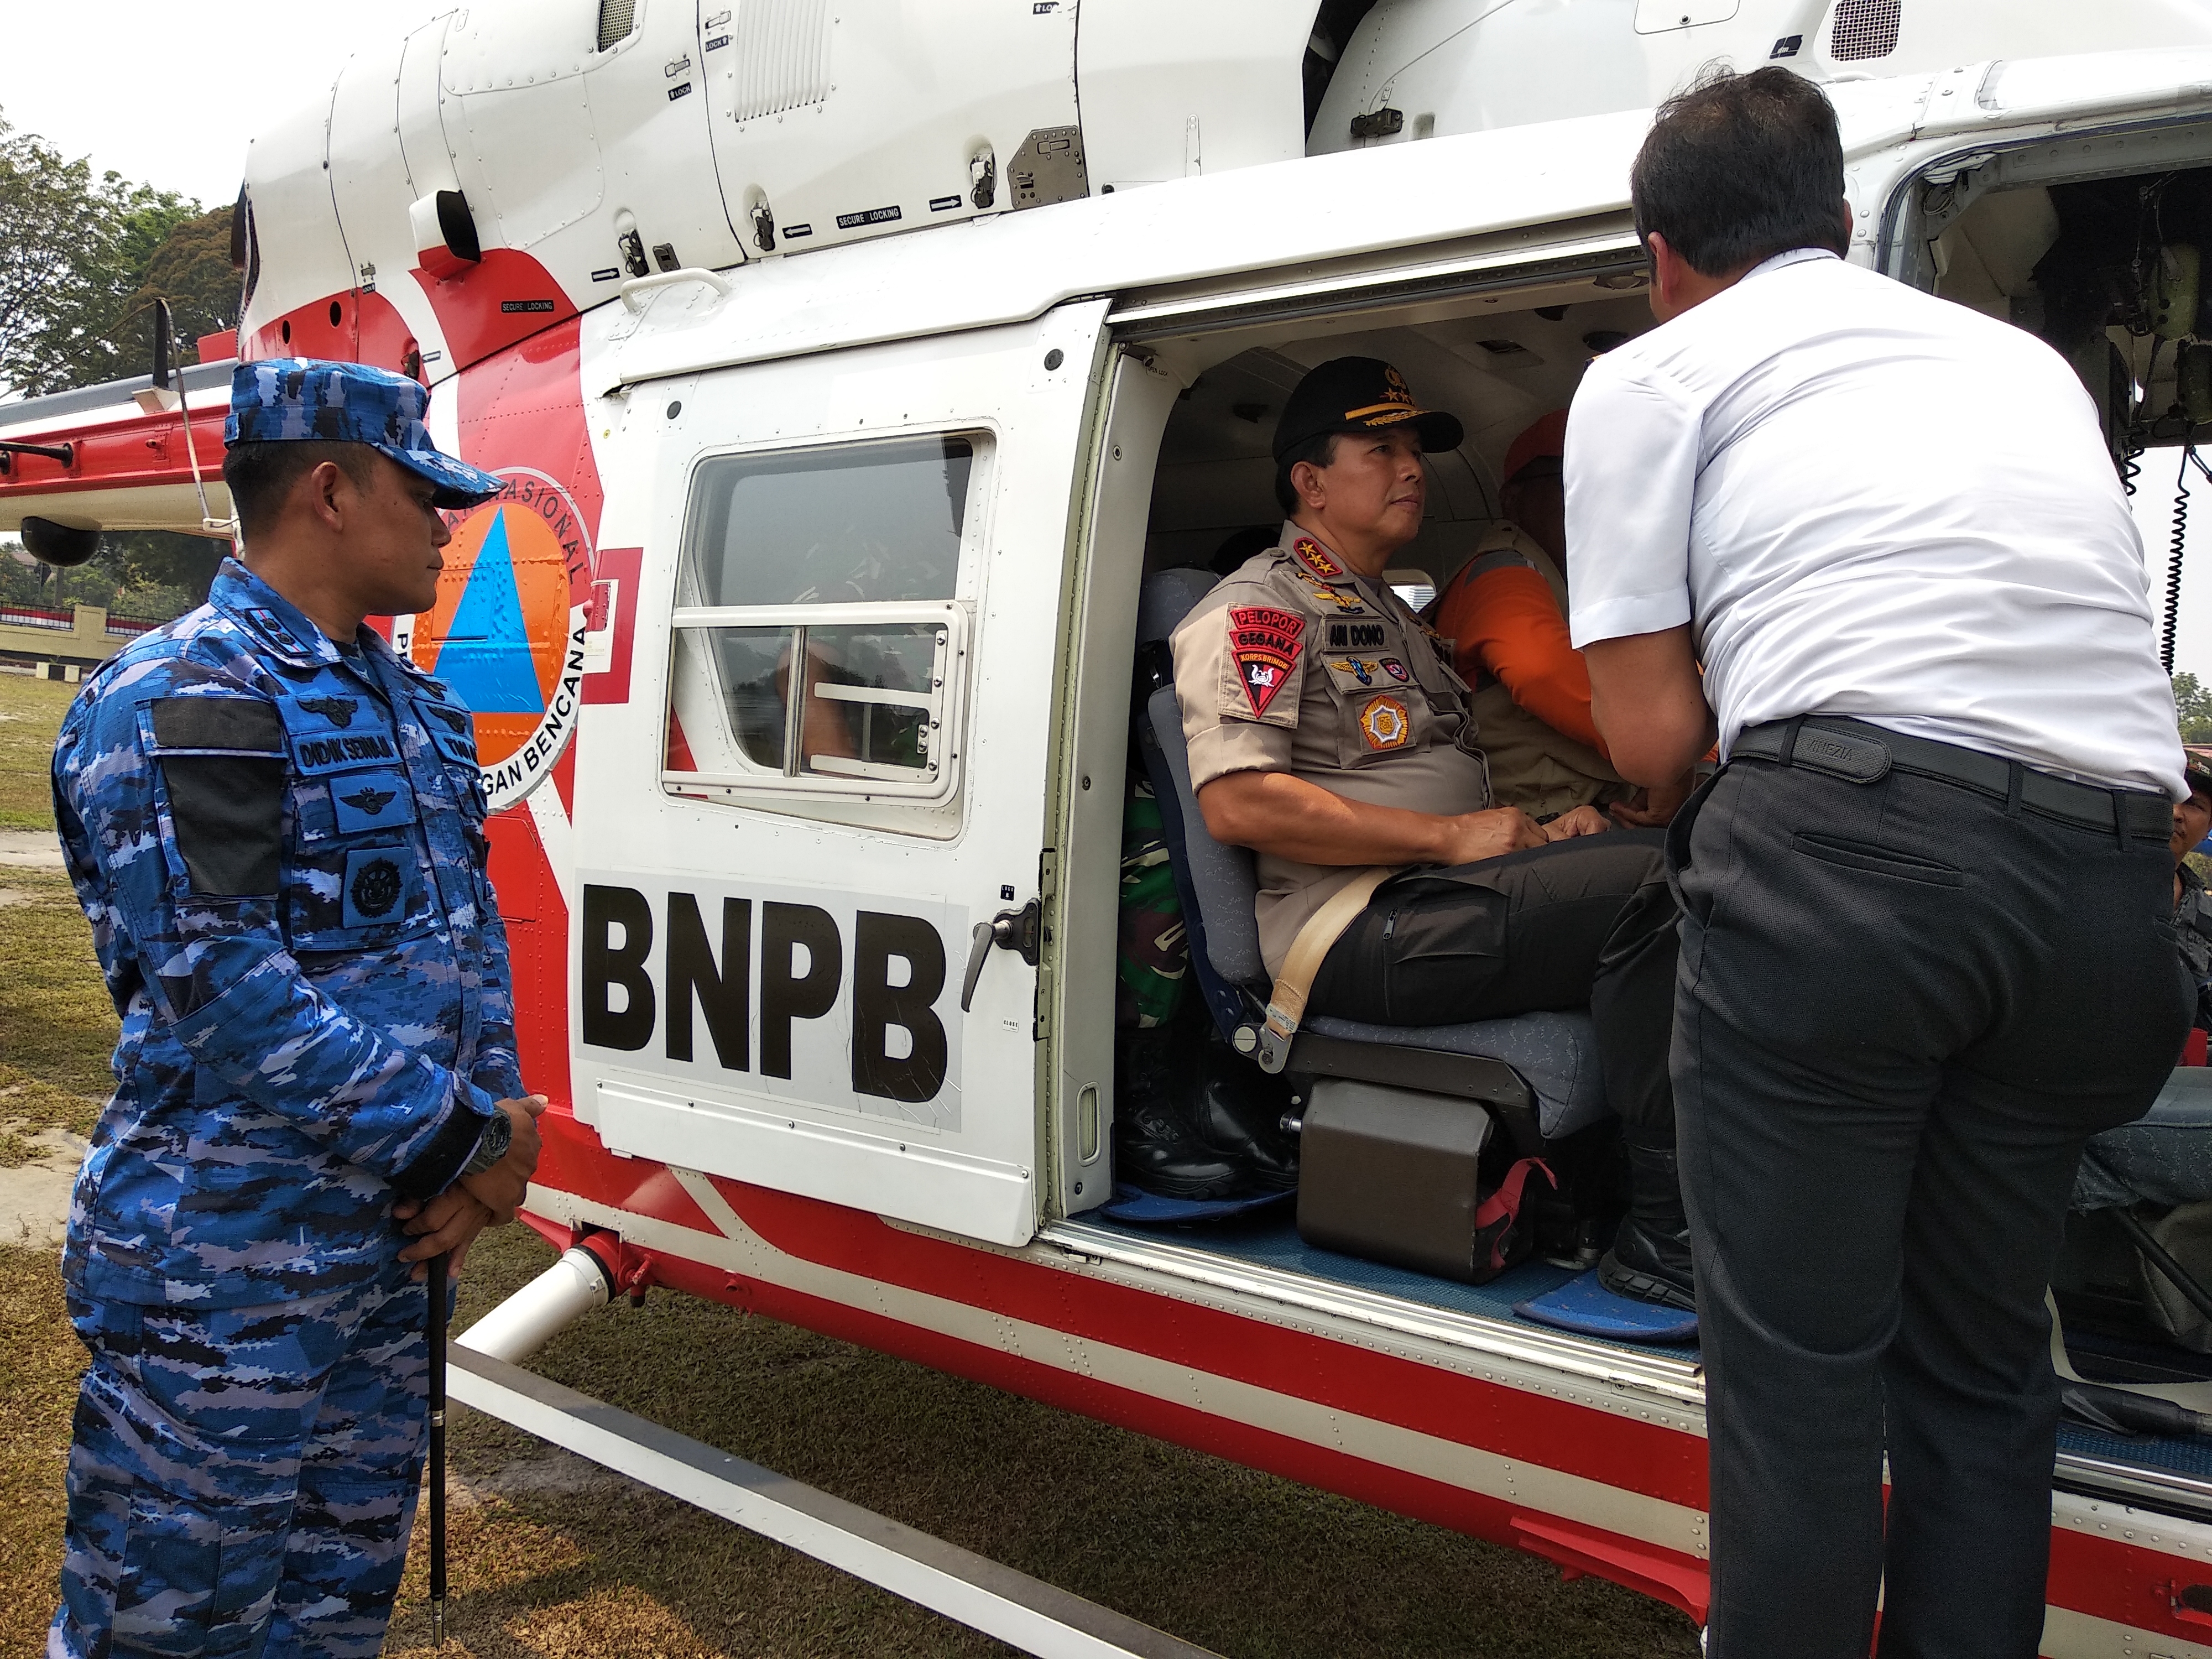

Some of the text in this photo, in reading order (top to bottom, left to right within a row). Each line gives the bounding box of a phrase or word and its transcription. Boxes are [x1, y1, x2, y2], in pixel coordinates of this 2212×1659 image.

[706, 39, 722, 50] LOCK
[675, 85, 691, 96] LOCK
[839, 208, 899, 226] SECURE LOCKING
[528, 302, 552, 310] LOCKING
[1239, 611, 1297, 635] PELOPOR
[1239, 633, 1294, 655] GEGANA
[1350, 624, 1385, 646] DONO
[1241, 654, 1288, 669] KORPS BRIMOB
[528, 626, 586, 773] BENCANA
[300, 738, 348, 768] DIDIK
[583, 884, 947, 1103] BNPB
